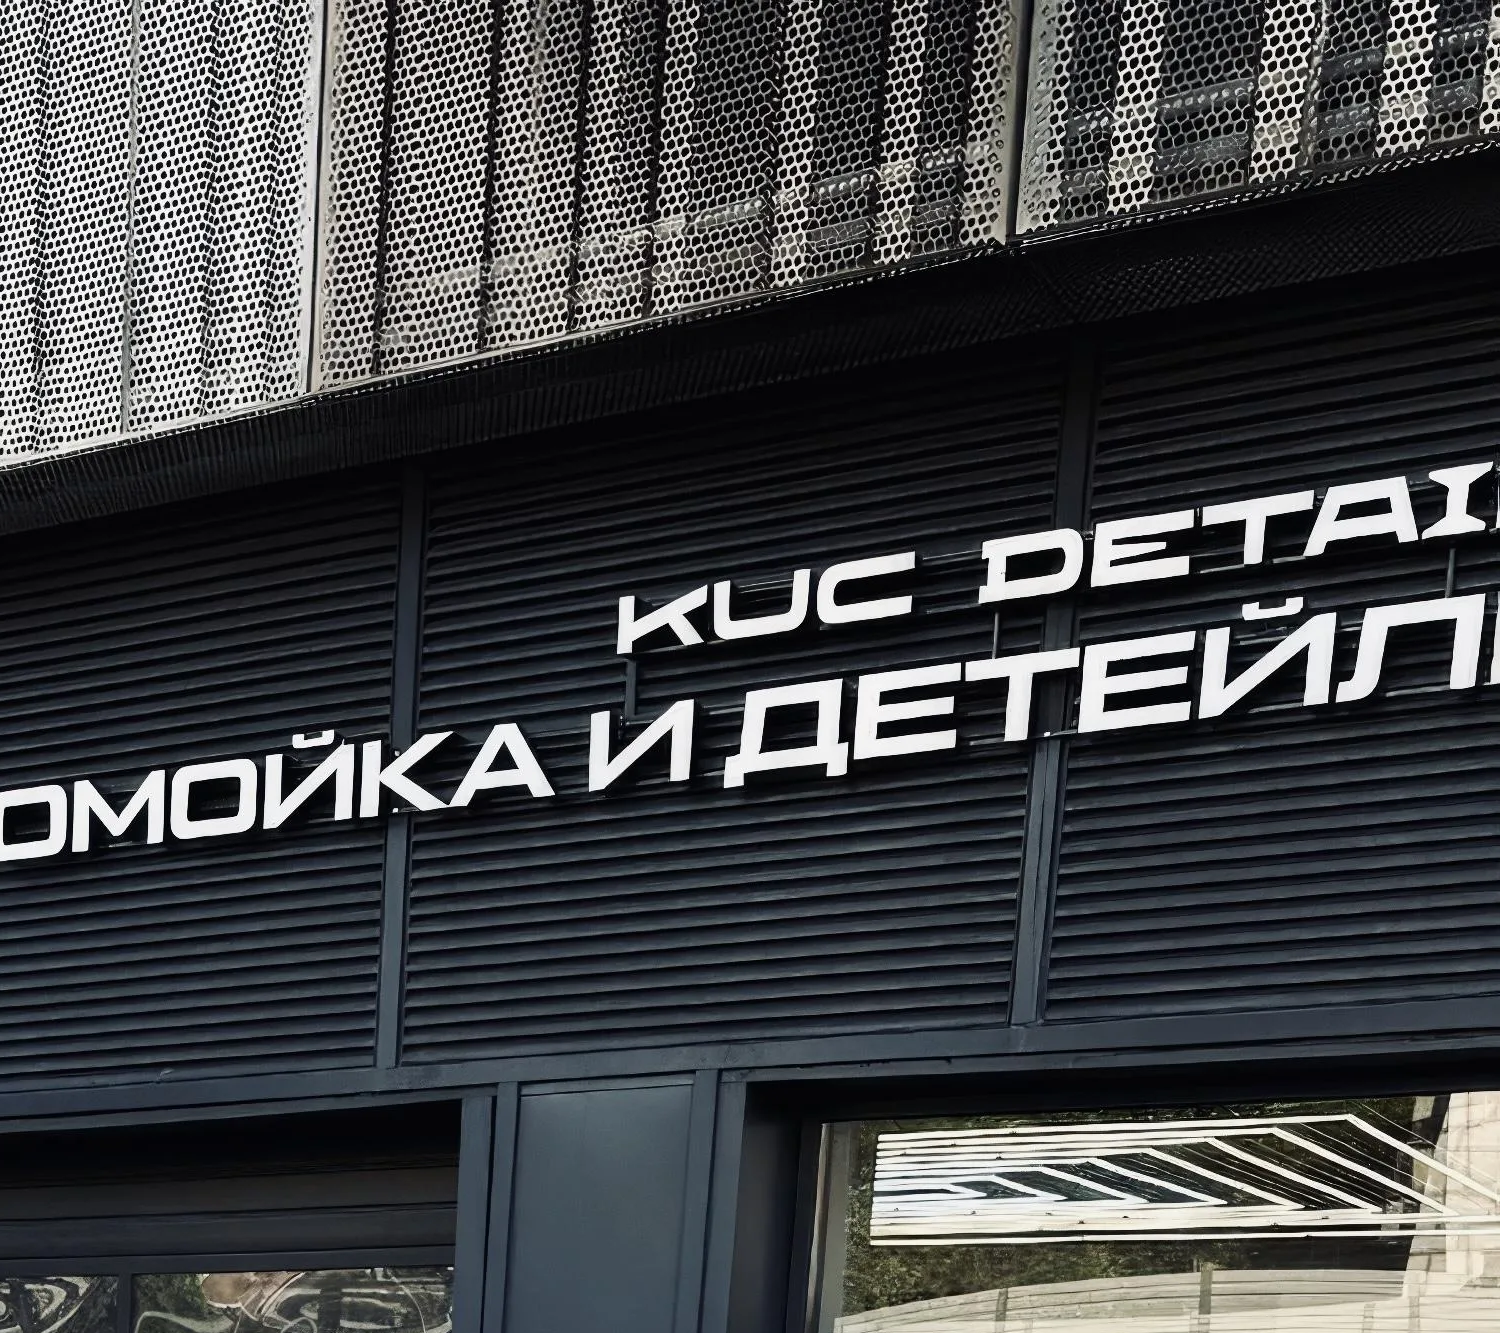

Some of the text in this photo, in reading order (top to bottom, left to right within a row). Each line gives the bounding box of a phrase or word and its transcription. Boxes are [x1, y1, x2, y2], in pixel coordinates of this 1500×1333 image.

[617, 460, 1500, 655] KUC DETAI
[588, 699, 695, 793] И
[723, 593, 1500, 789] ДЕТЕЙЛ
